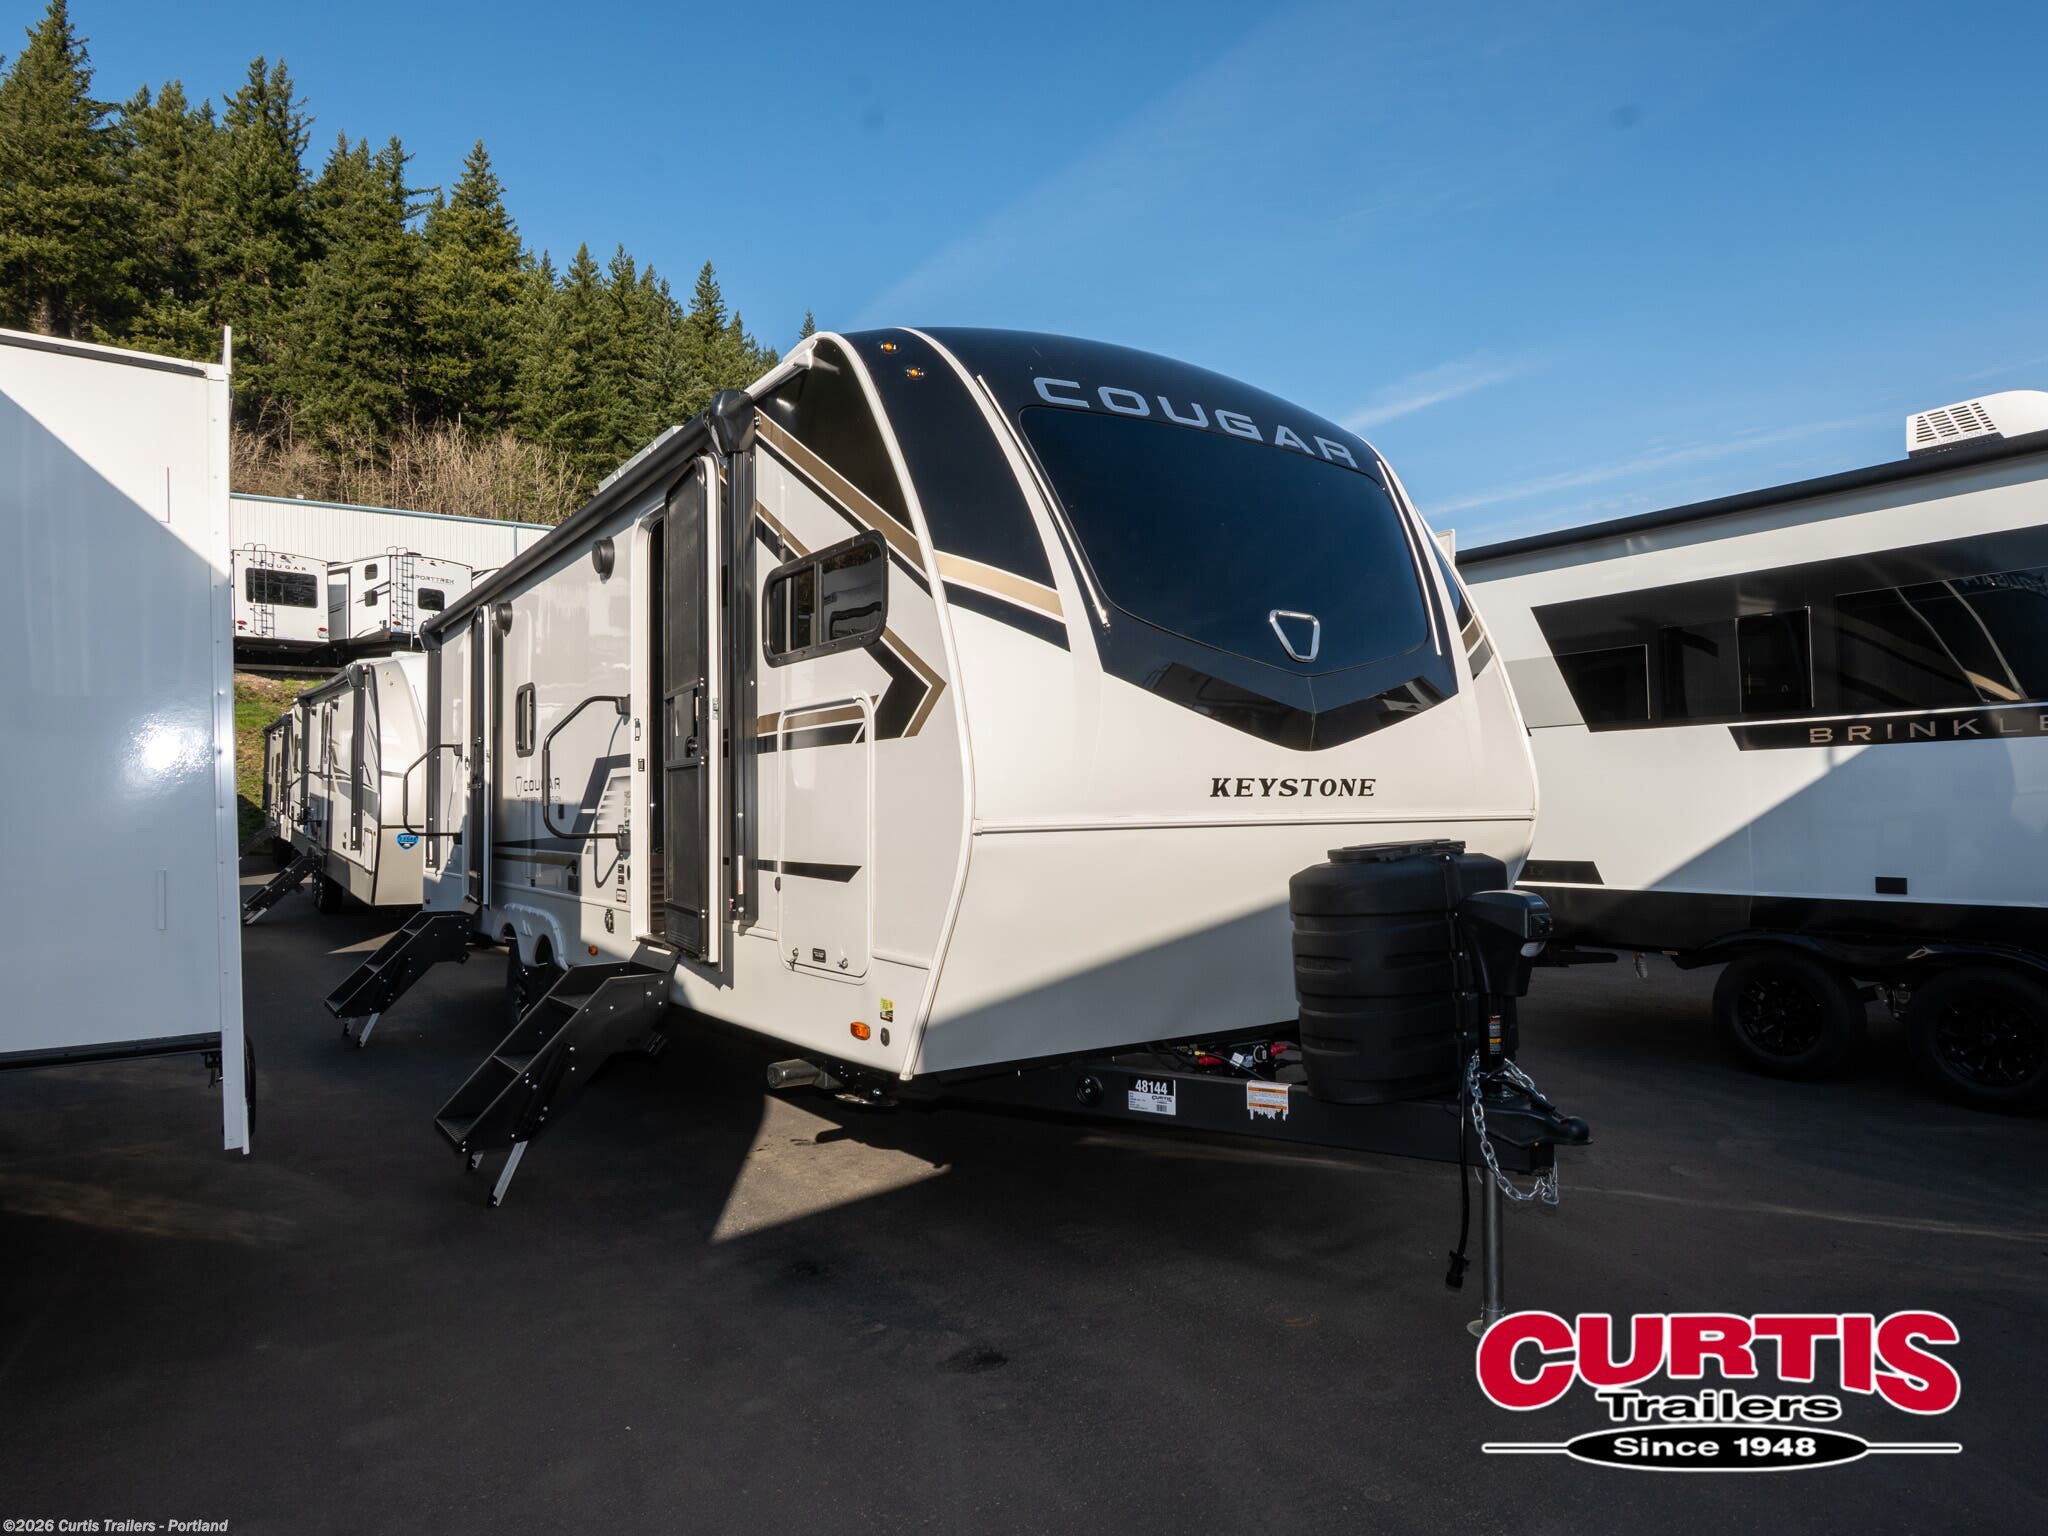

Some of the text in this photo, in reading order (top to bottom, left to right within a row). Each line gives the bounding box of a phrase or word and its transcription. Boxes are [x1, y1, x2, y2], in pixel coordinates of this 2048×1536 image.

[1033, 377, 1357, 468] COUGAR
[411, 574, 455, 585] PORTTREK
[523, 776, 561, 792] COUAR
[1210, 777, 1376, 798] KEYSTONE
[1135, 1079, 1168, 1095] 48144
